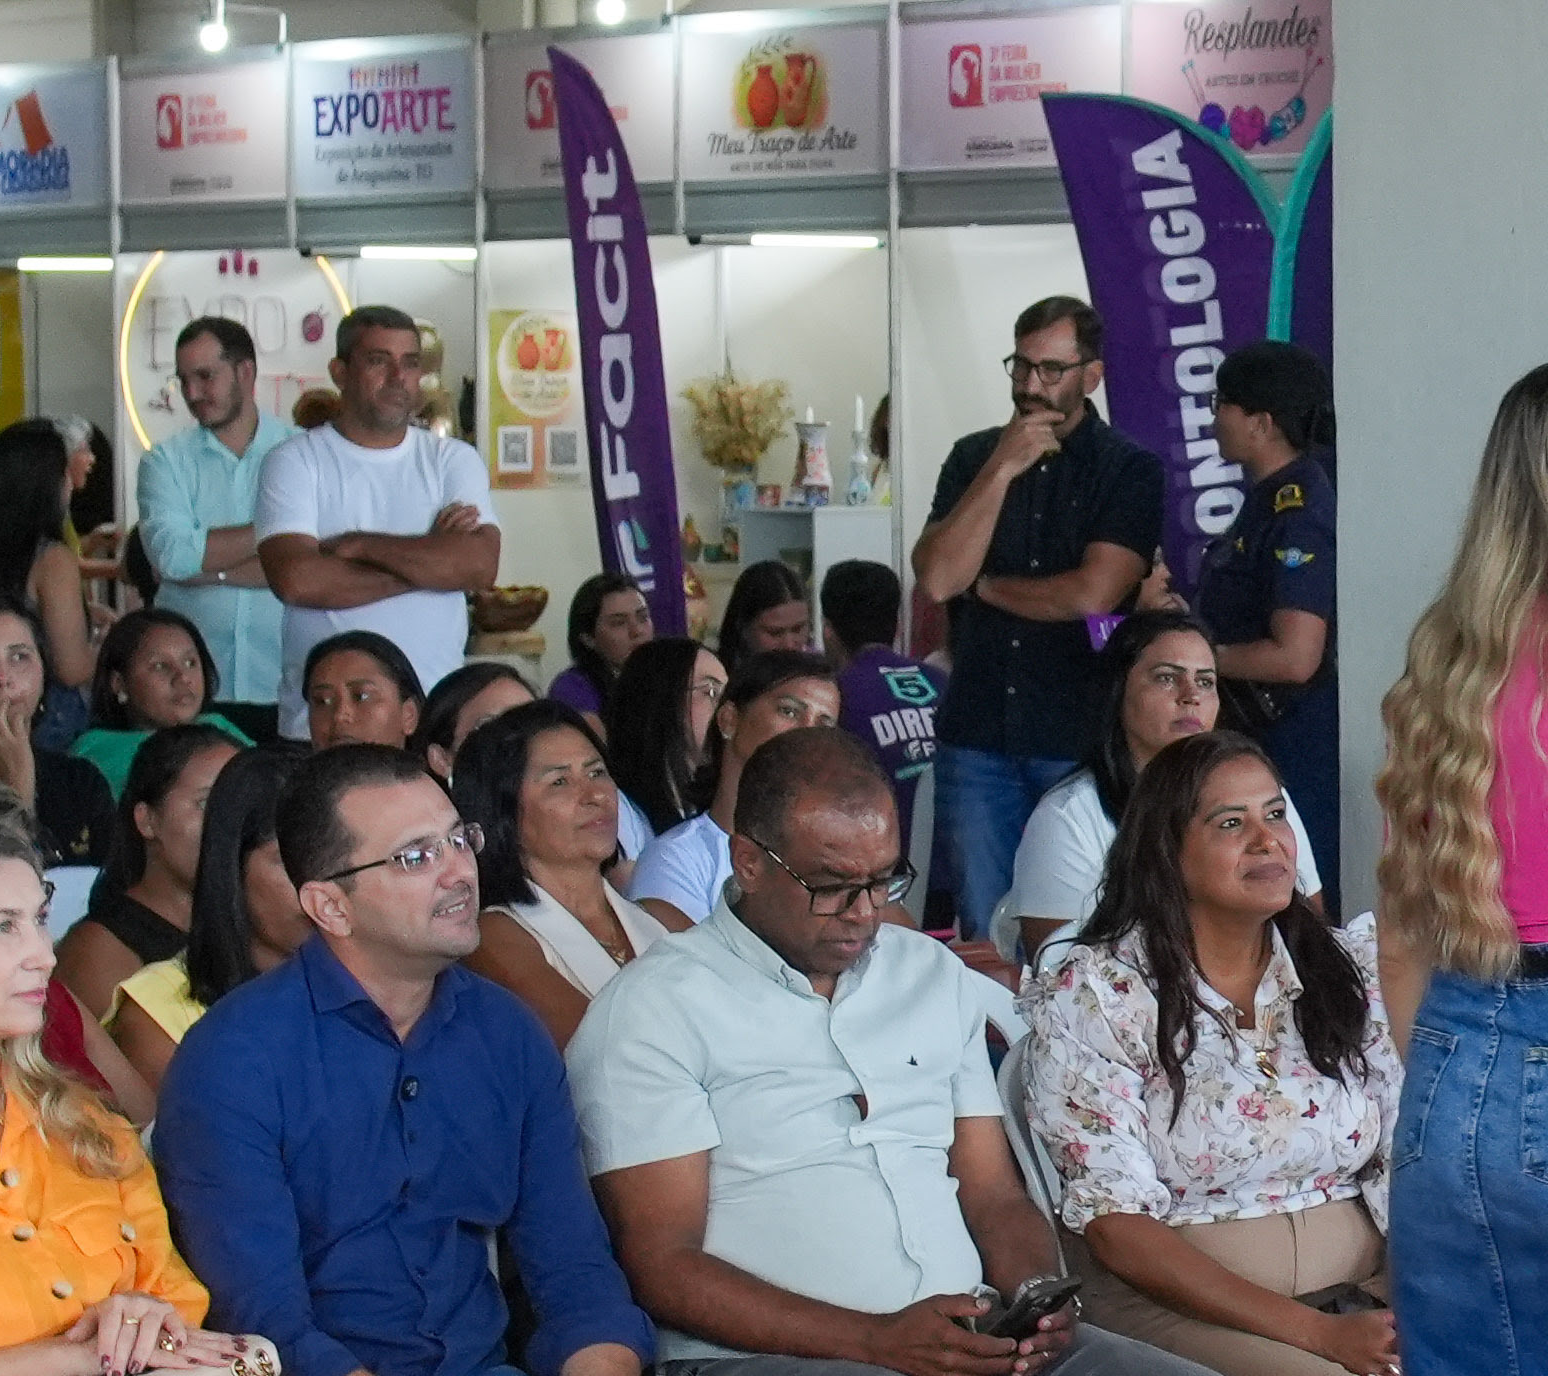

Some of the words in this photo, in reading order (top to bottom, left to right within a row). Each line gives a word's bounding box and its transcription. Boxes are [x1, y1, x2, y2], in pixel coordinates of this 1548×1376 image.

[313, 87, 456, 137] EXPOARTE
[1184, 4, 1323, 62] Resplandes
[581, 146, 641, 501] Facit
[1131, 128, 1246, 536] ONTOLOGIA
